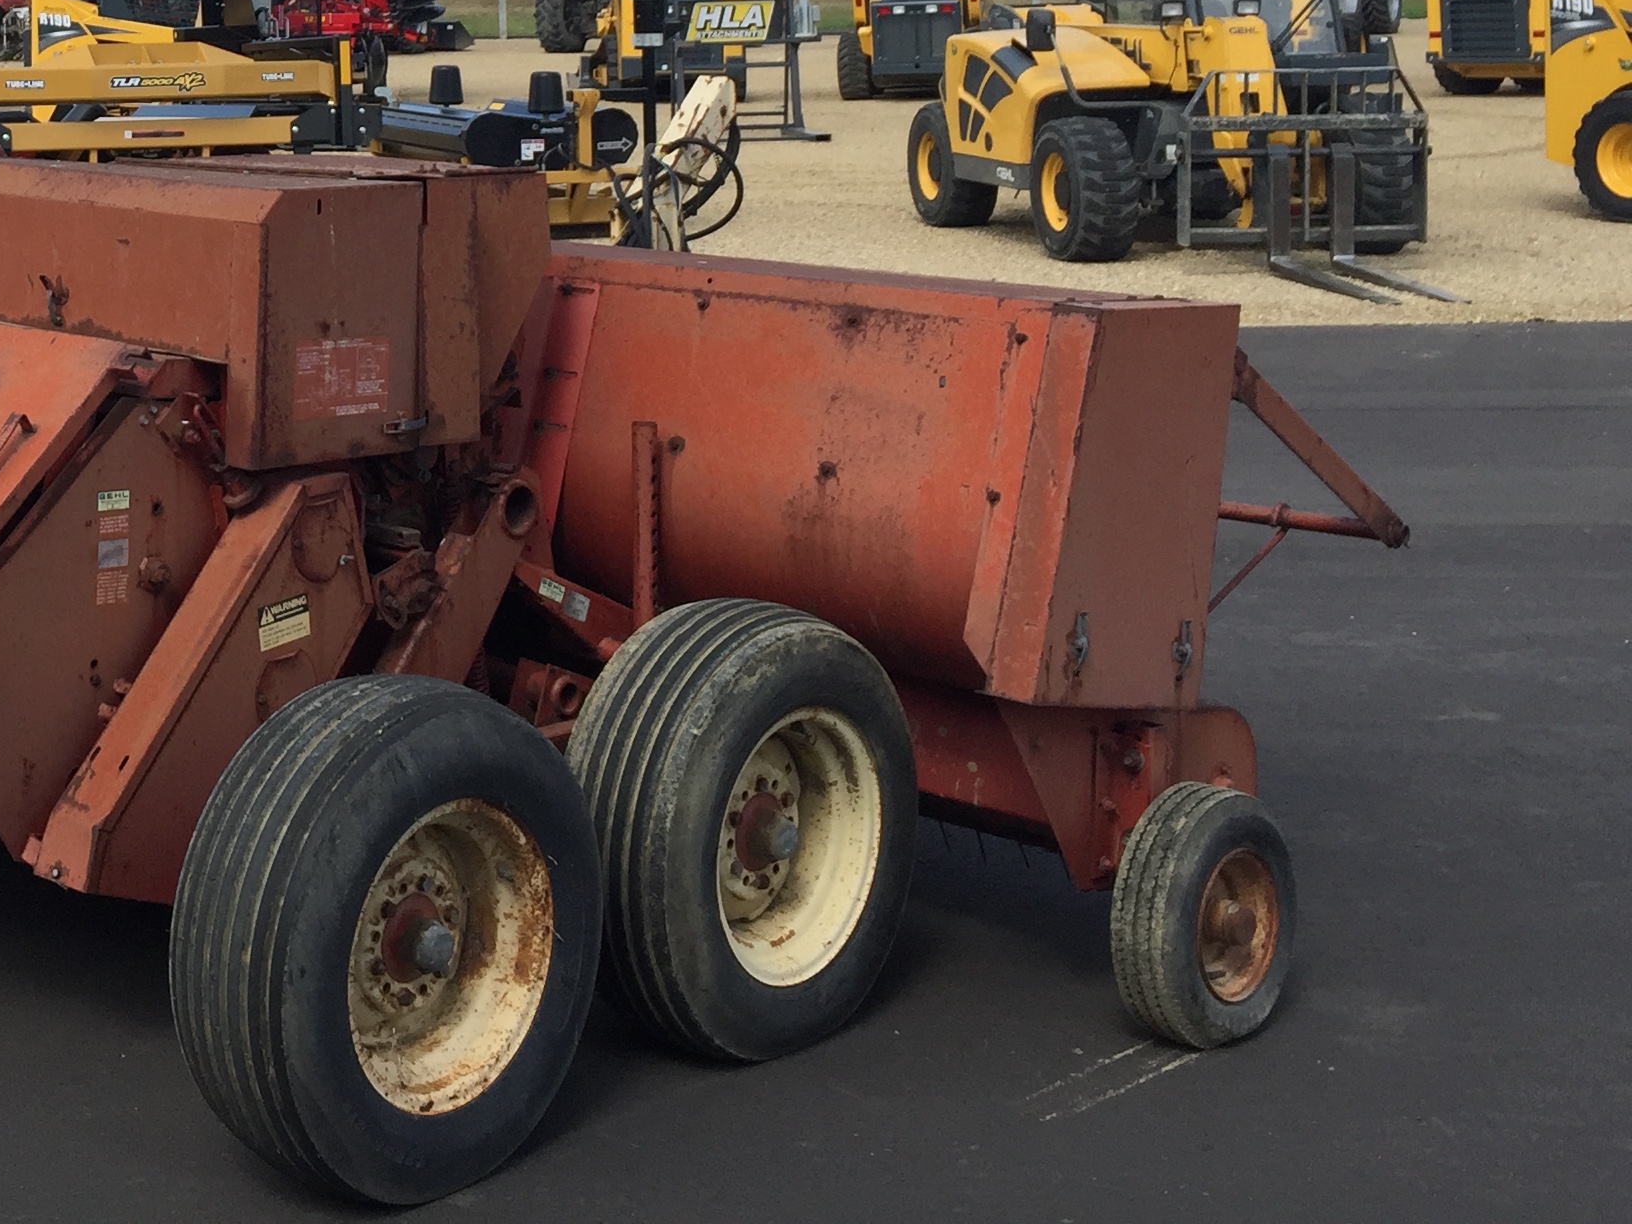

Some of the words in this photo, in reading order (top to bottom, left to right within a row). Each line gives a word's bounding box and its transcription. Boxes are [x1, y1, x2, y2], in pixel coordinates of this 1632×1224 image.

[39, 12, 71, 28] R190
[696, 4, 766, 30] HLA
[695, 28, 761, 39] ATTACHMENTS
[1229, 26, 1260, 35] GEHL
[112, 77, 141, 87] TLR
[140, 78, 174, 86] 5000
[99, 491, 129, 500] GEHL
[269, 594, 308, 616] WARNING
